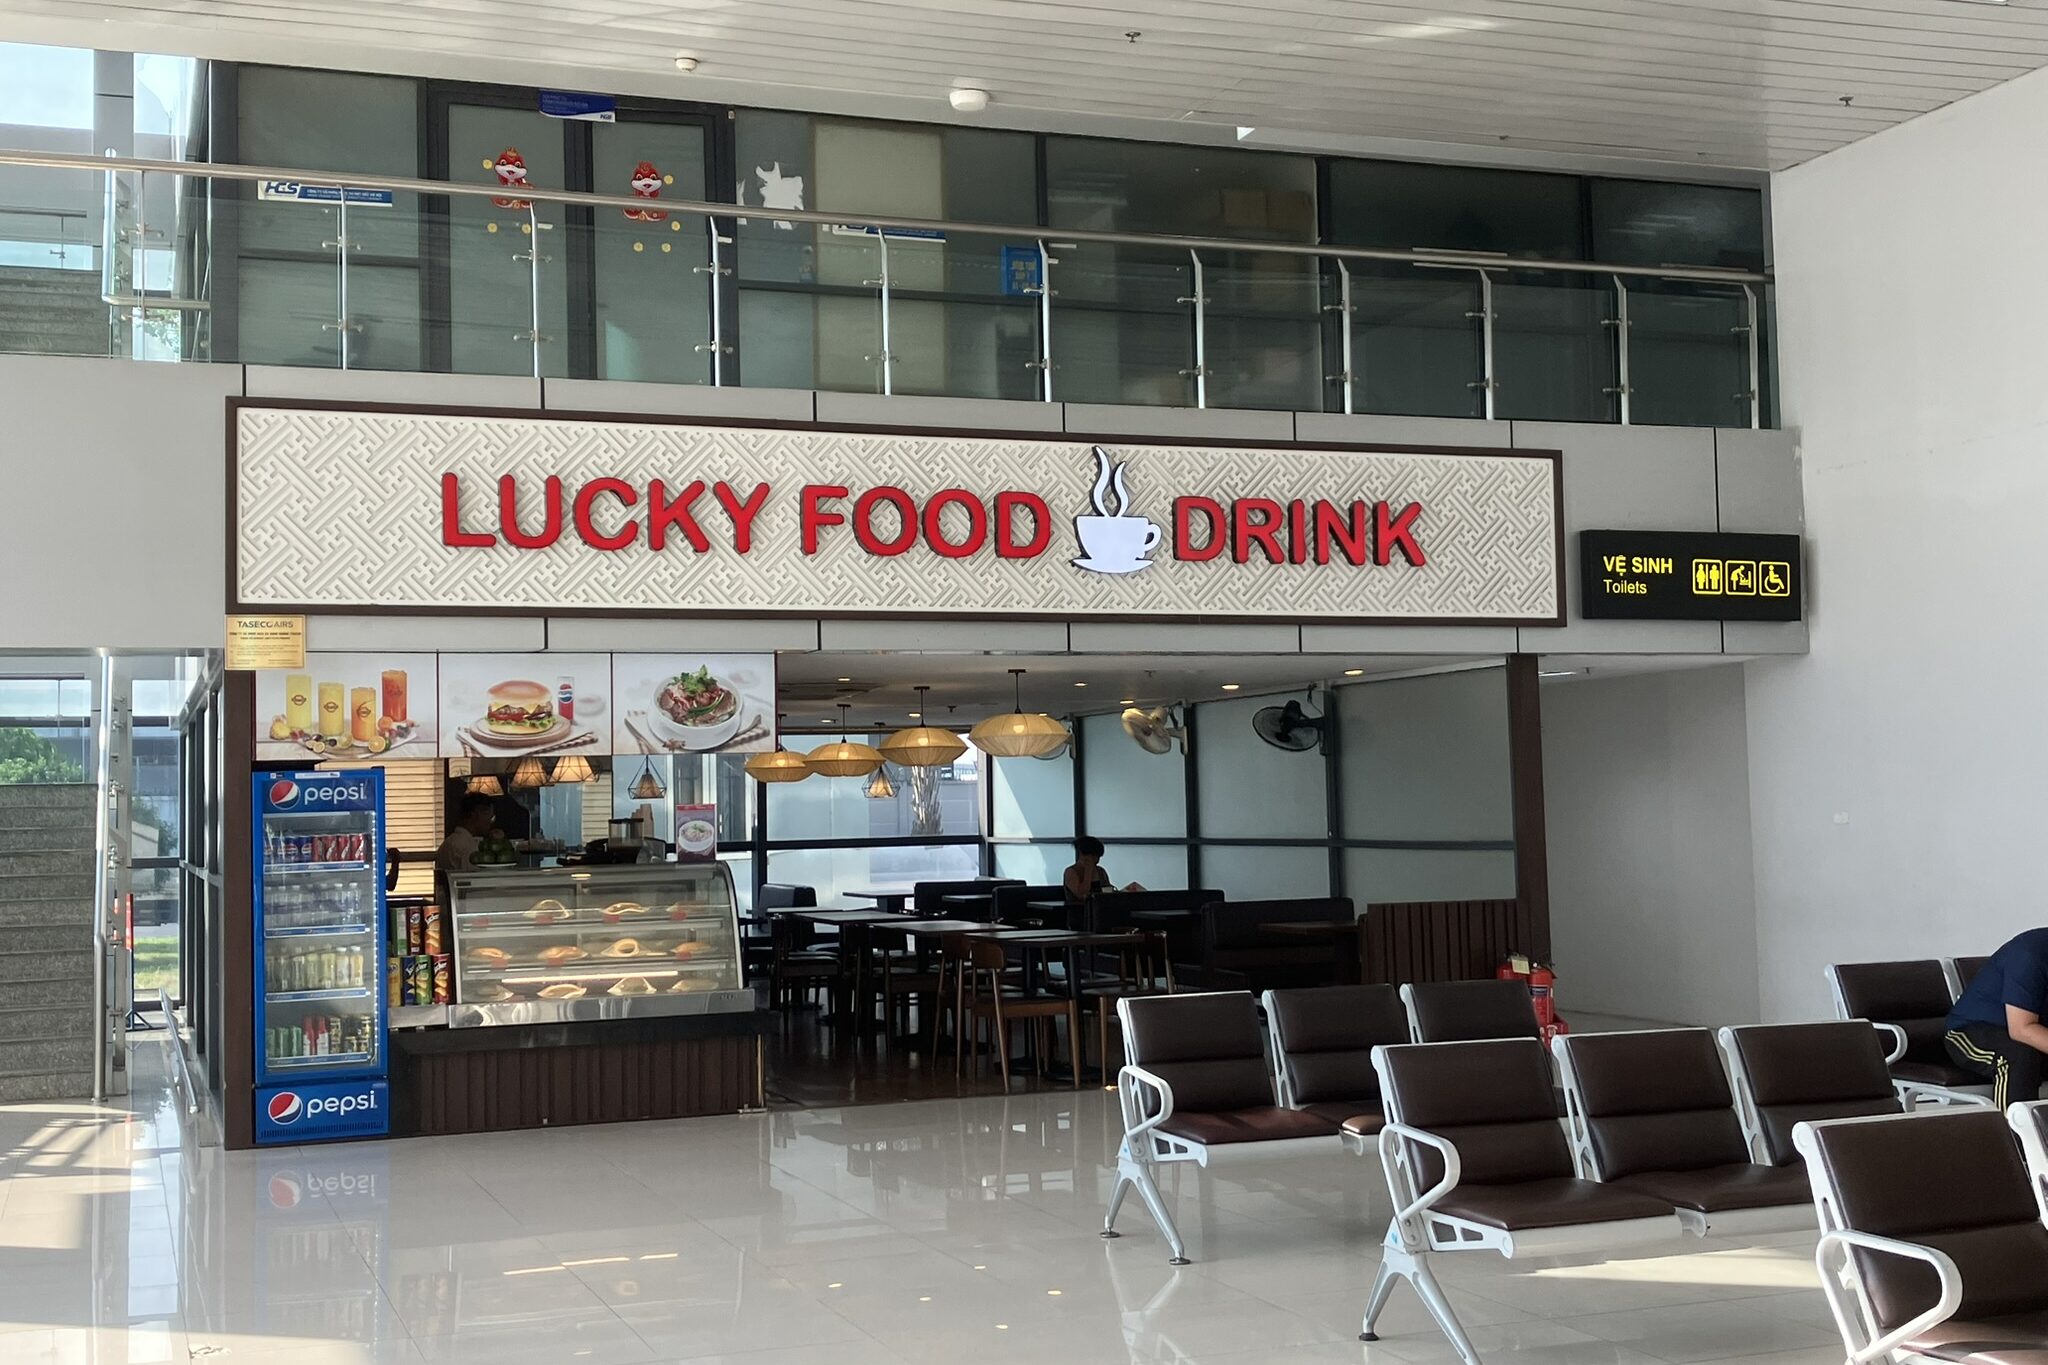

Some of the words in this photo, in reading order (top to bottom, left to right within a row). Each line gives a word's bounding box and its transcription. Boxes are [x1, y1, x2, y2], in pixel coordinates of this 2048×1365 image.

[441, 472, 771, 553] LUCKY
[800, 485, 1051, 558] FOOD
[1172, 495, 1426, 567] DRINK
[1603, 555, 1627, 577] VỆ
[1631, 557, 1673, 574] SINH
[1603, 579, 1648, 594] Toilets
[304, 783, 364, 805] pepsi
[307, 1090, 375, 1118] pepsi
